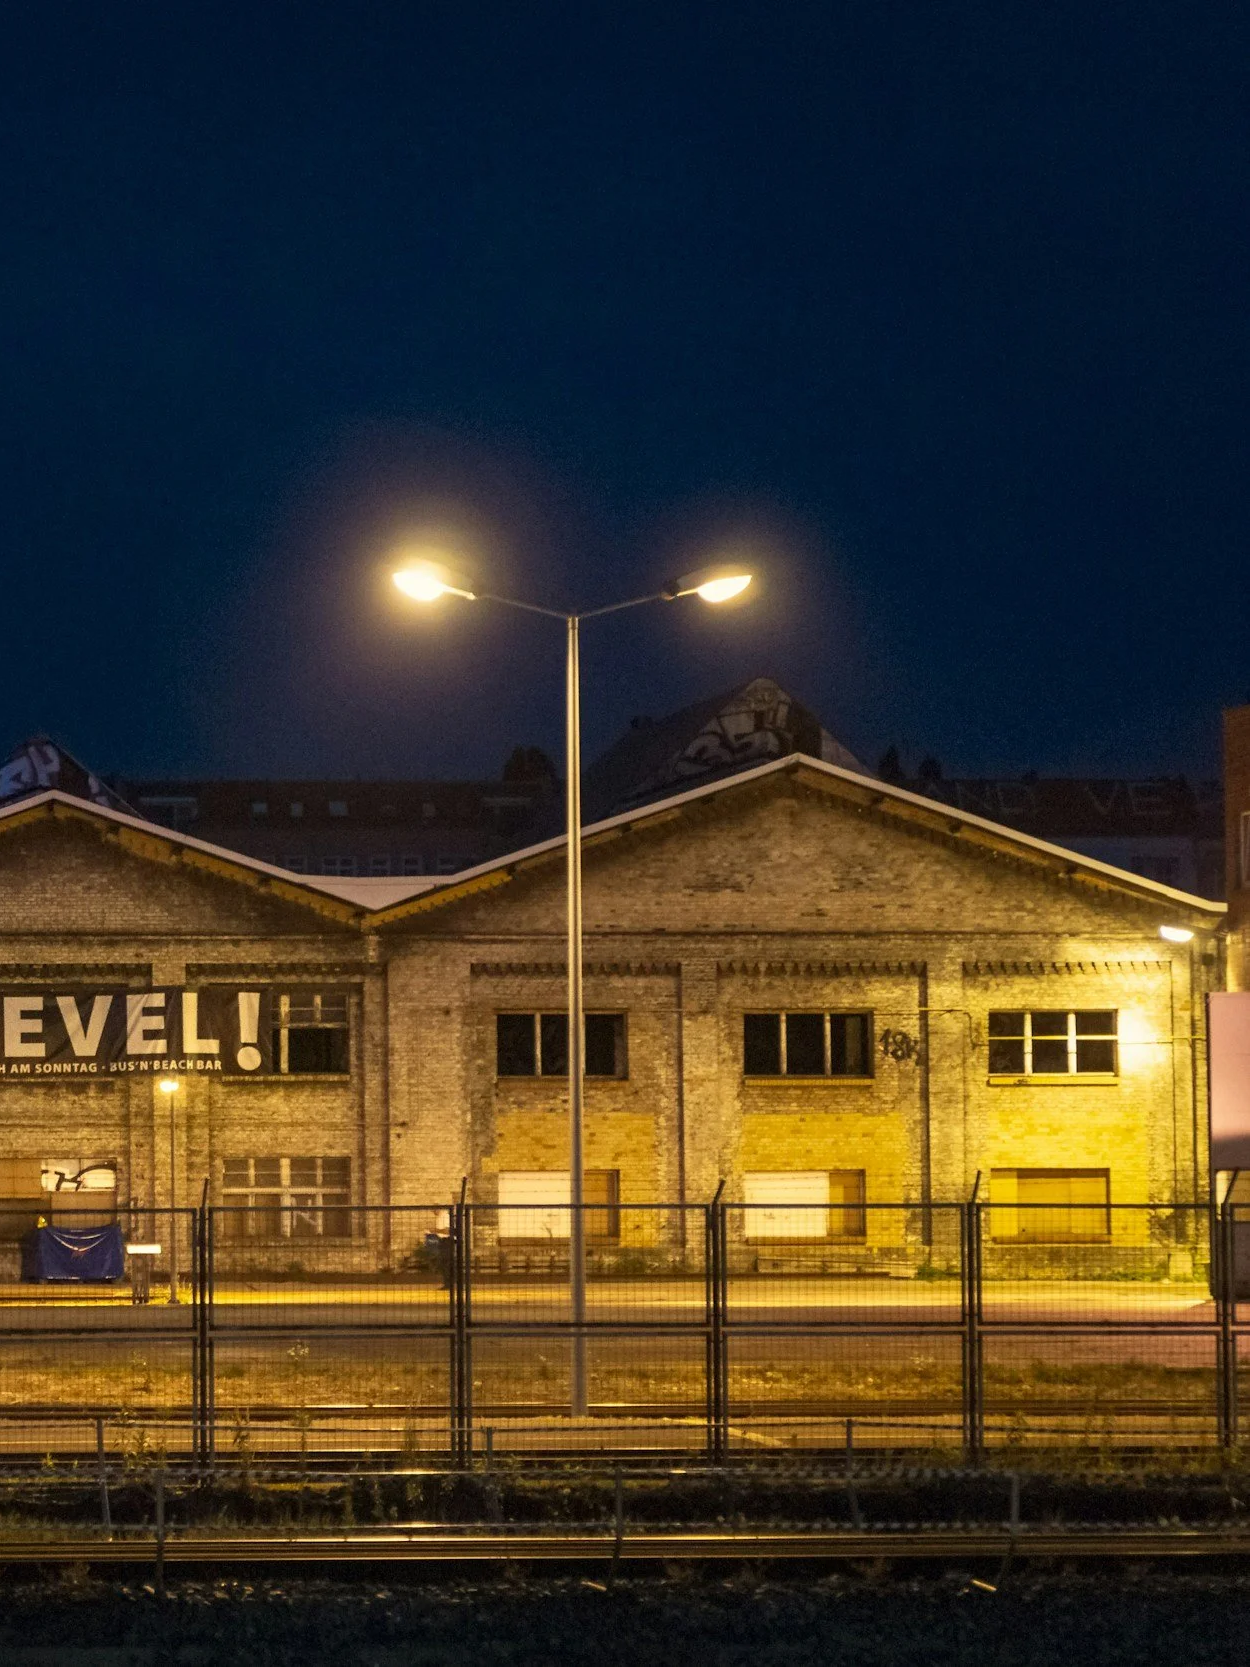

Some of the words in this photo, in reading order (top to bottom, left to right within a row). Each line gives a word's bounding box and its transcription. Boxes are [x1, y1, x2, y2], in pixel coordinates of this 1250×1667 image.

[10, 1062, 31, 1073] AM
[35, 1062, 98, 1073] SONNTAG
[196, 1059, 222, 1070] BAR
